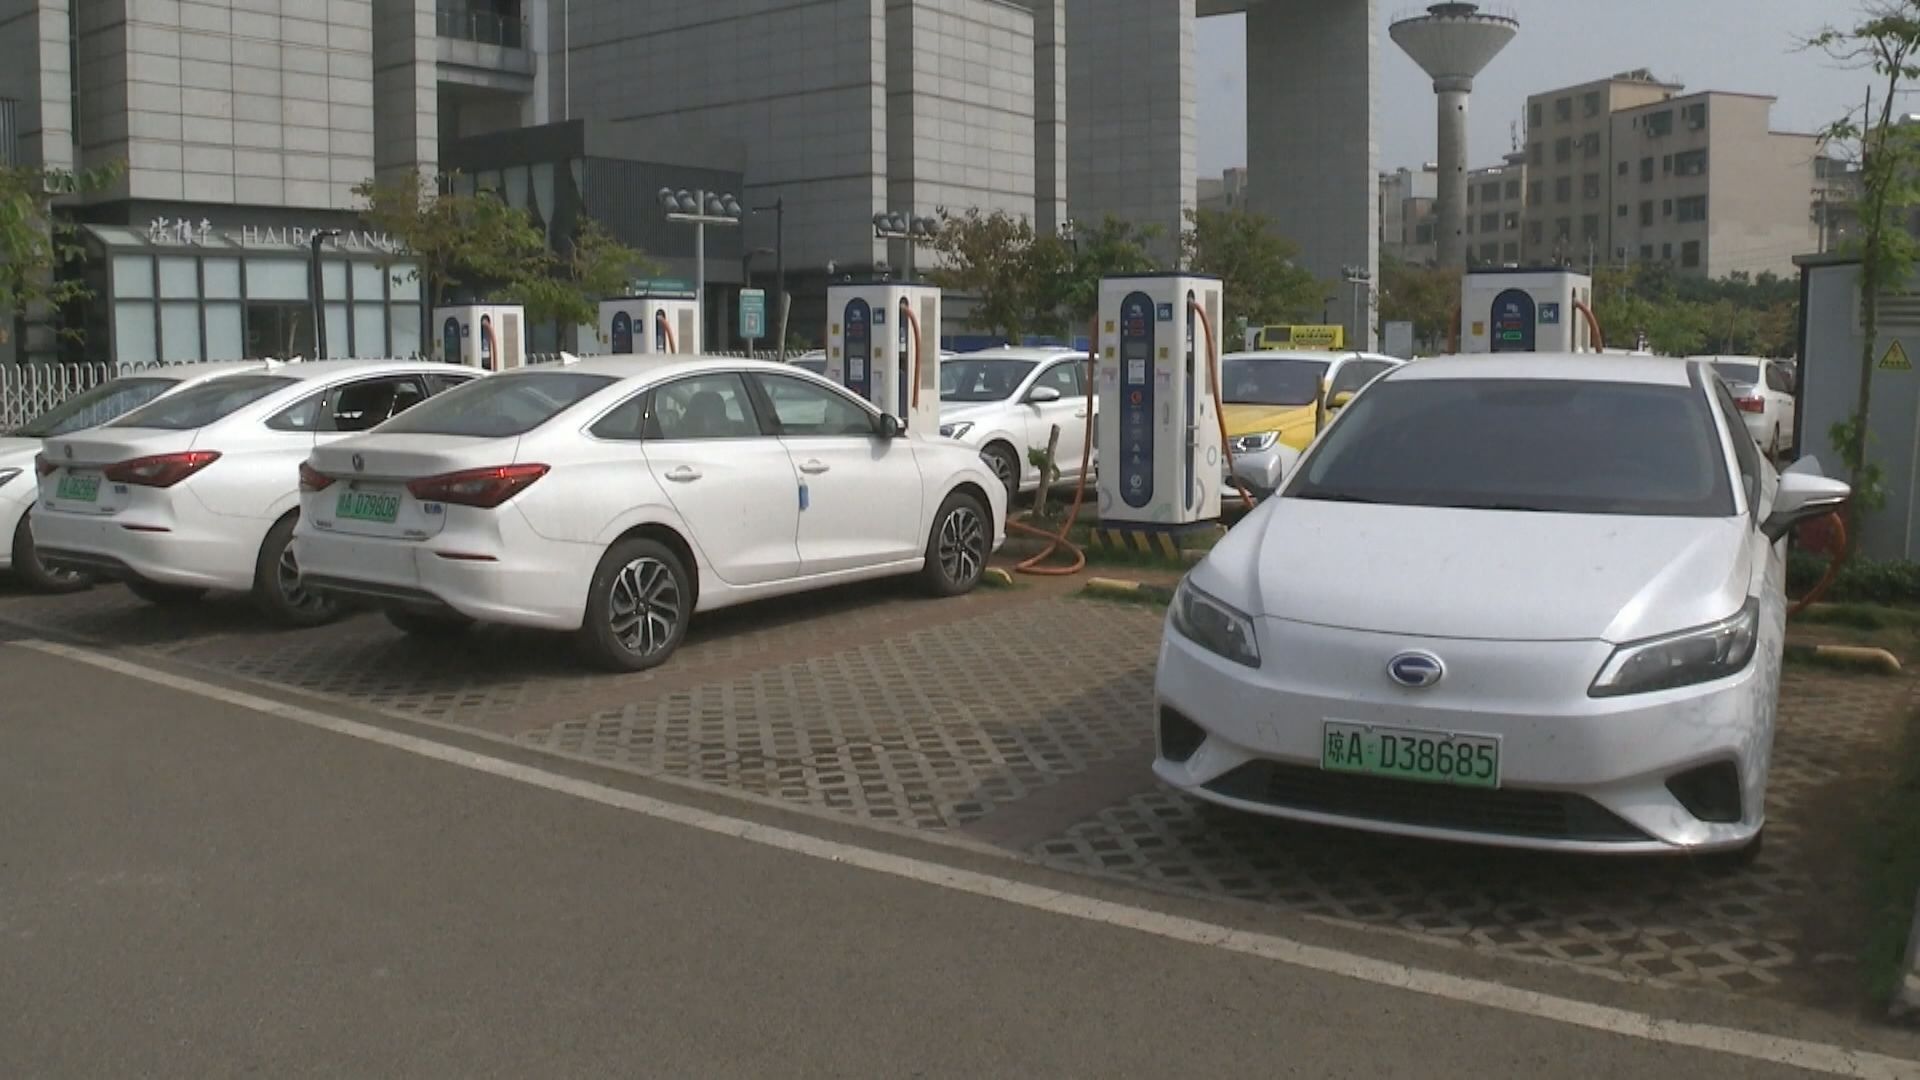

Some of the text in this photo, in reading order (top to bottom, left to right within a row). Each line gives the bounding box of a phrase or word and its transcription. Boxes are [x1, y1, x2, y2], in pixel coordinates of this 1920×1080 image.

[1542, 310, 1554, 319] 04
[1328, 731, 1493, 778] 琼A D38685
